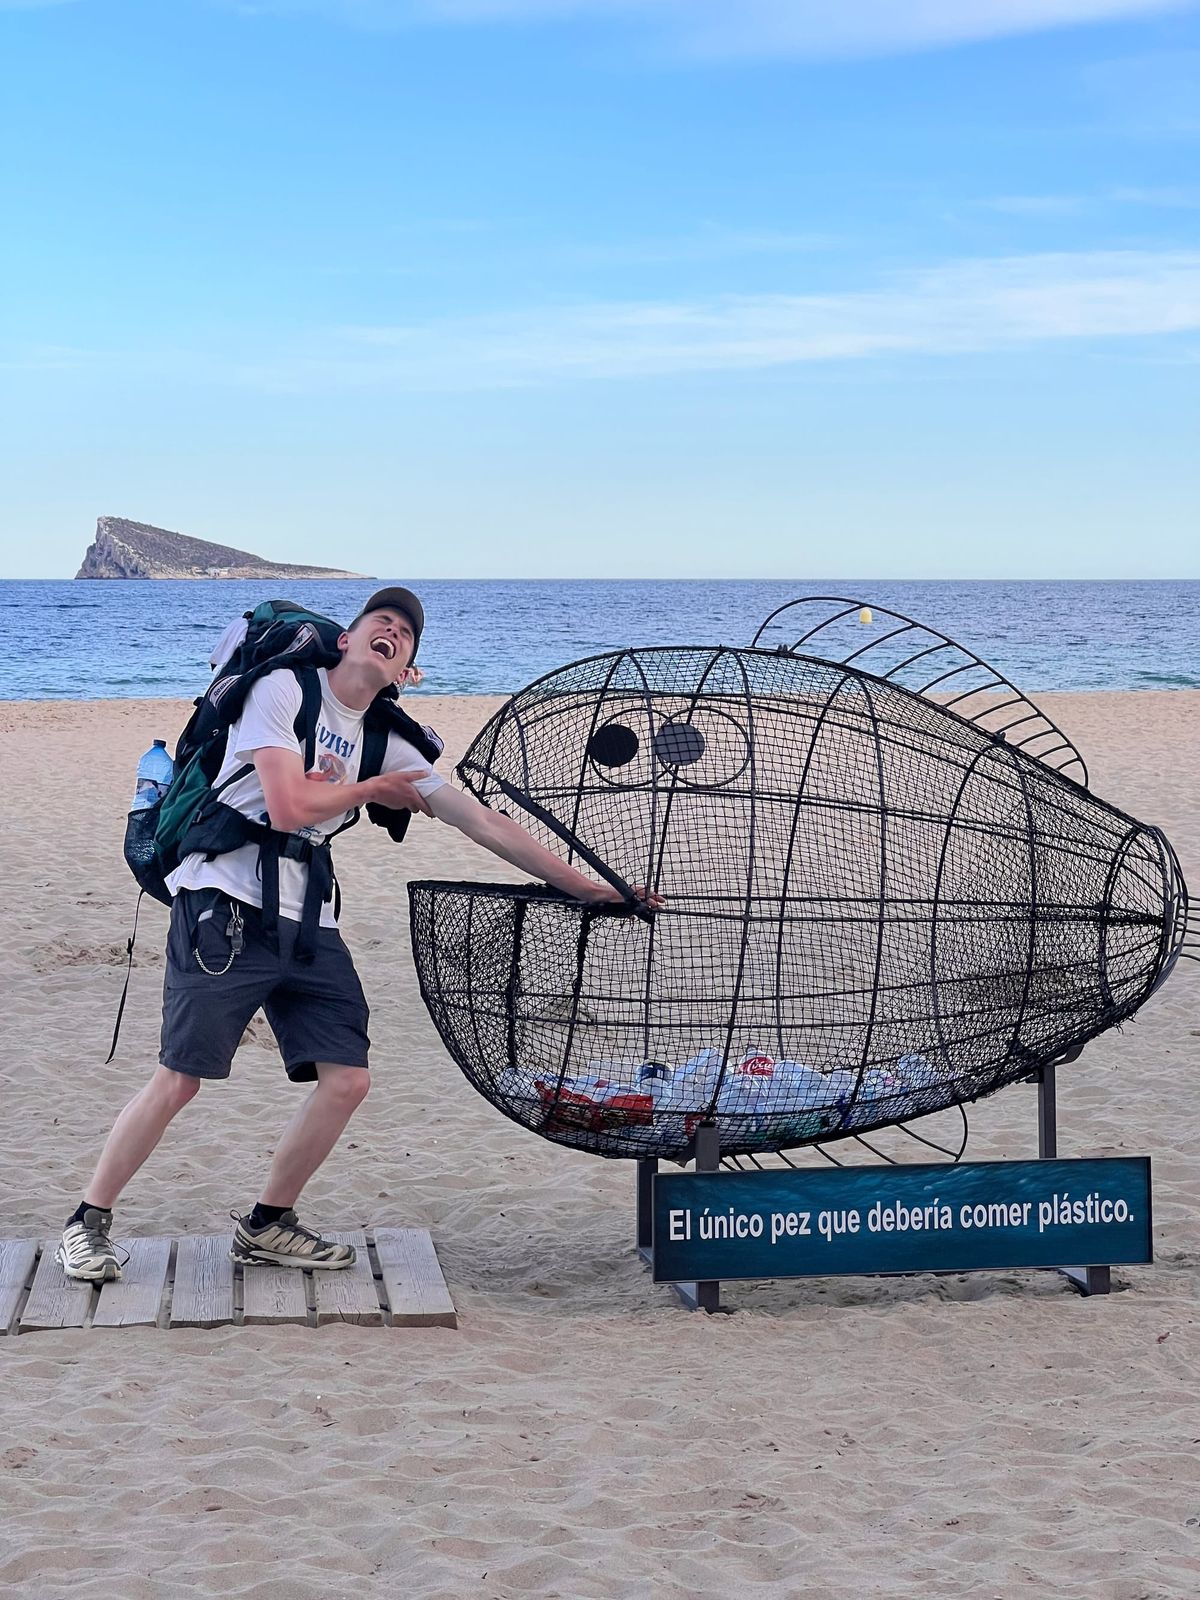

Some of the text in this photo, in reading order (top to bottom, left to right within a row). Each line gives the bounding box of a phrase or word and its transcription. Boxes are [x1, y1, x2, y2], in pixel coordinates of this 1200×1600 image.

[669, 1192, 1135, 1244] El único pez que debería comer plástico.
